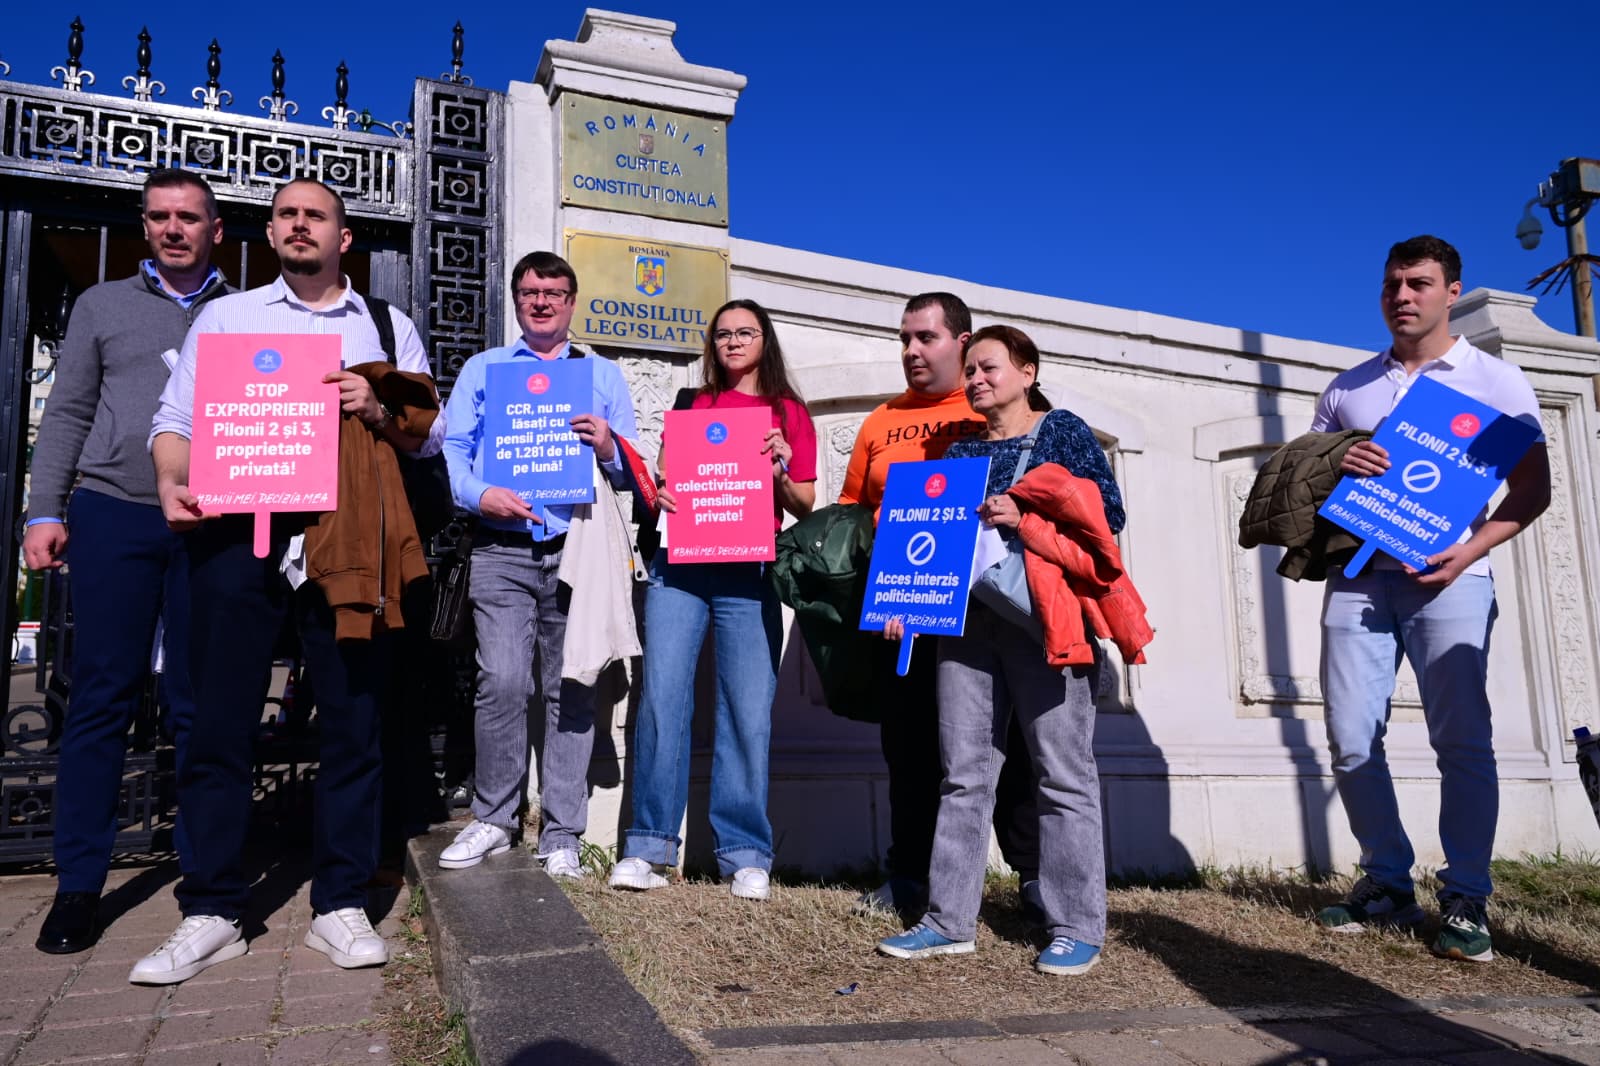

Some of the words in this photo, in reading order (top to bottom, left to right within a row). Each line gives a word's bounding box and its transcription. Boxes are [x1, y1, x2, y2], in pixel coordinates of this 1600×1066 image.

[616, 153, 682, 176] CURTEA
[590, 298, 707, 325] CONSILIUL
[245, 383, 289, 398] STOP
[205, 402, 326, 417] EXPROPRIERII!
[506, 404, 535, 416] CCR,
[538, 404, 553, 414] nu
[555, 403, 571, 412] ne
[213, 422, 264, 437] Pilonii
[268, 423, 279, 436] 2
[283, 422, 297, 439] și
[301, 422, 315, 437] 3,
[512, 417, 546, 430] lăsați
[550, 418, 565, 427] cu
[496, 432, 533, 447] pensii
[536, 430, 580, 445] private
[216, 442, 312, 460] proprietate
[497, 448, 511, 460] de
[515, 447, 544, 459] 1.281
[547, 446, 562, 457] de
[565, 444, 581, 456] lei
[1395, 421, 1449, 455] PILONII
[1445, 447, 1460, 461] 2
[1474, 460, 1489, 477] 3.
[229, 462, 296, 479] privată!
[513, 463, 528, 476] pe
[532, 460, 563, 473] lună!
[675, 479, 762, 492] colectivizarea
[302, 492, 328, 504] MEA
[692, 494, 746, 510] pensiilor
[1354, 477, 1400, 503] Acces
[1398, 494, 1452, 533] interzis
[695, 509, 744, 525] private!
[888, 507, 930, 523] PILONII
[931, 507, 940, 521] 2
[956, 506, 968, 520] 3.
[1345, 489, 1440, 545] politicienilor!
[749, 545, 769, 556] MEA
[876, 571, 911, 585] Acces
[913, 571, 960, 586] interzis
[874, 589, 954, 605] politicienilor!
[937, 616, 958, 628] MEA
